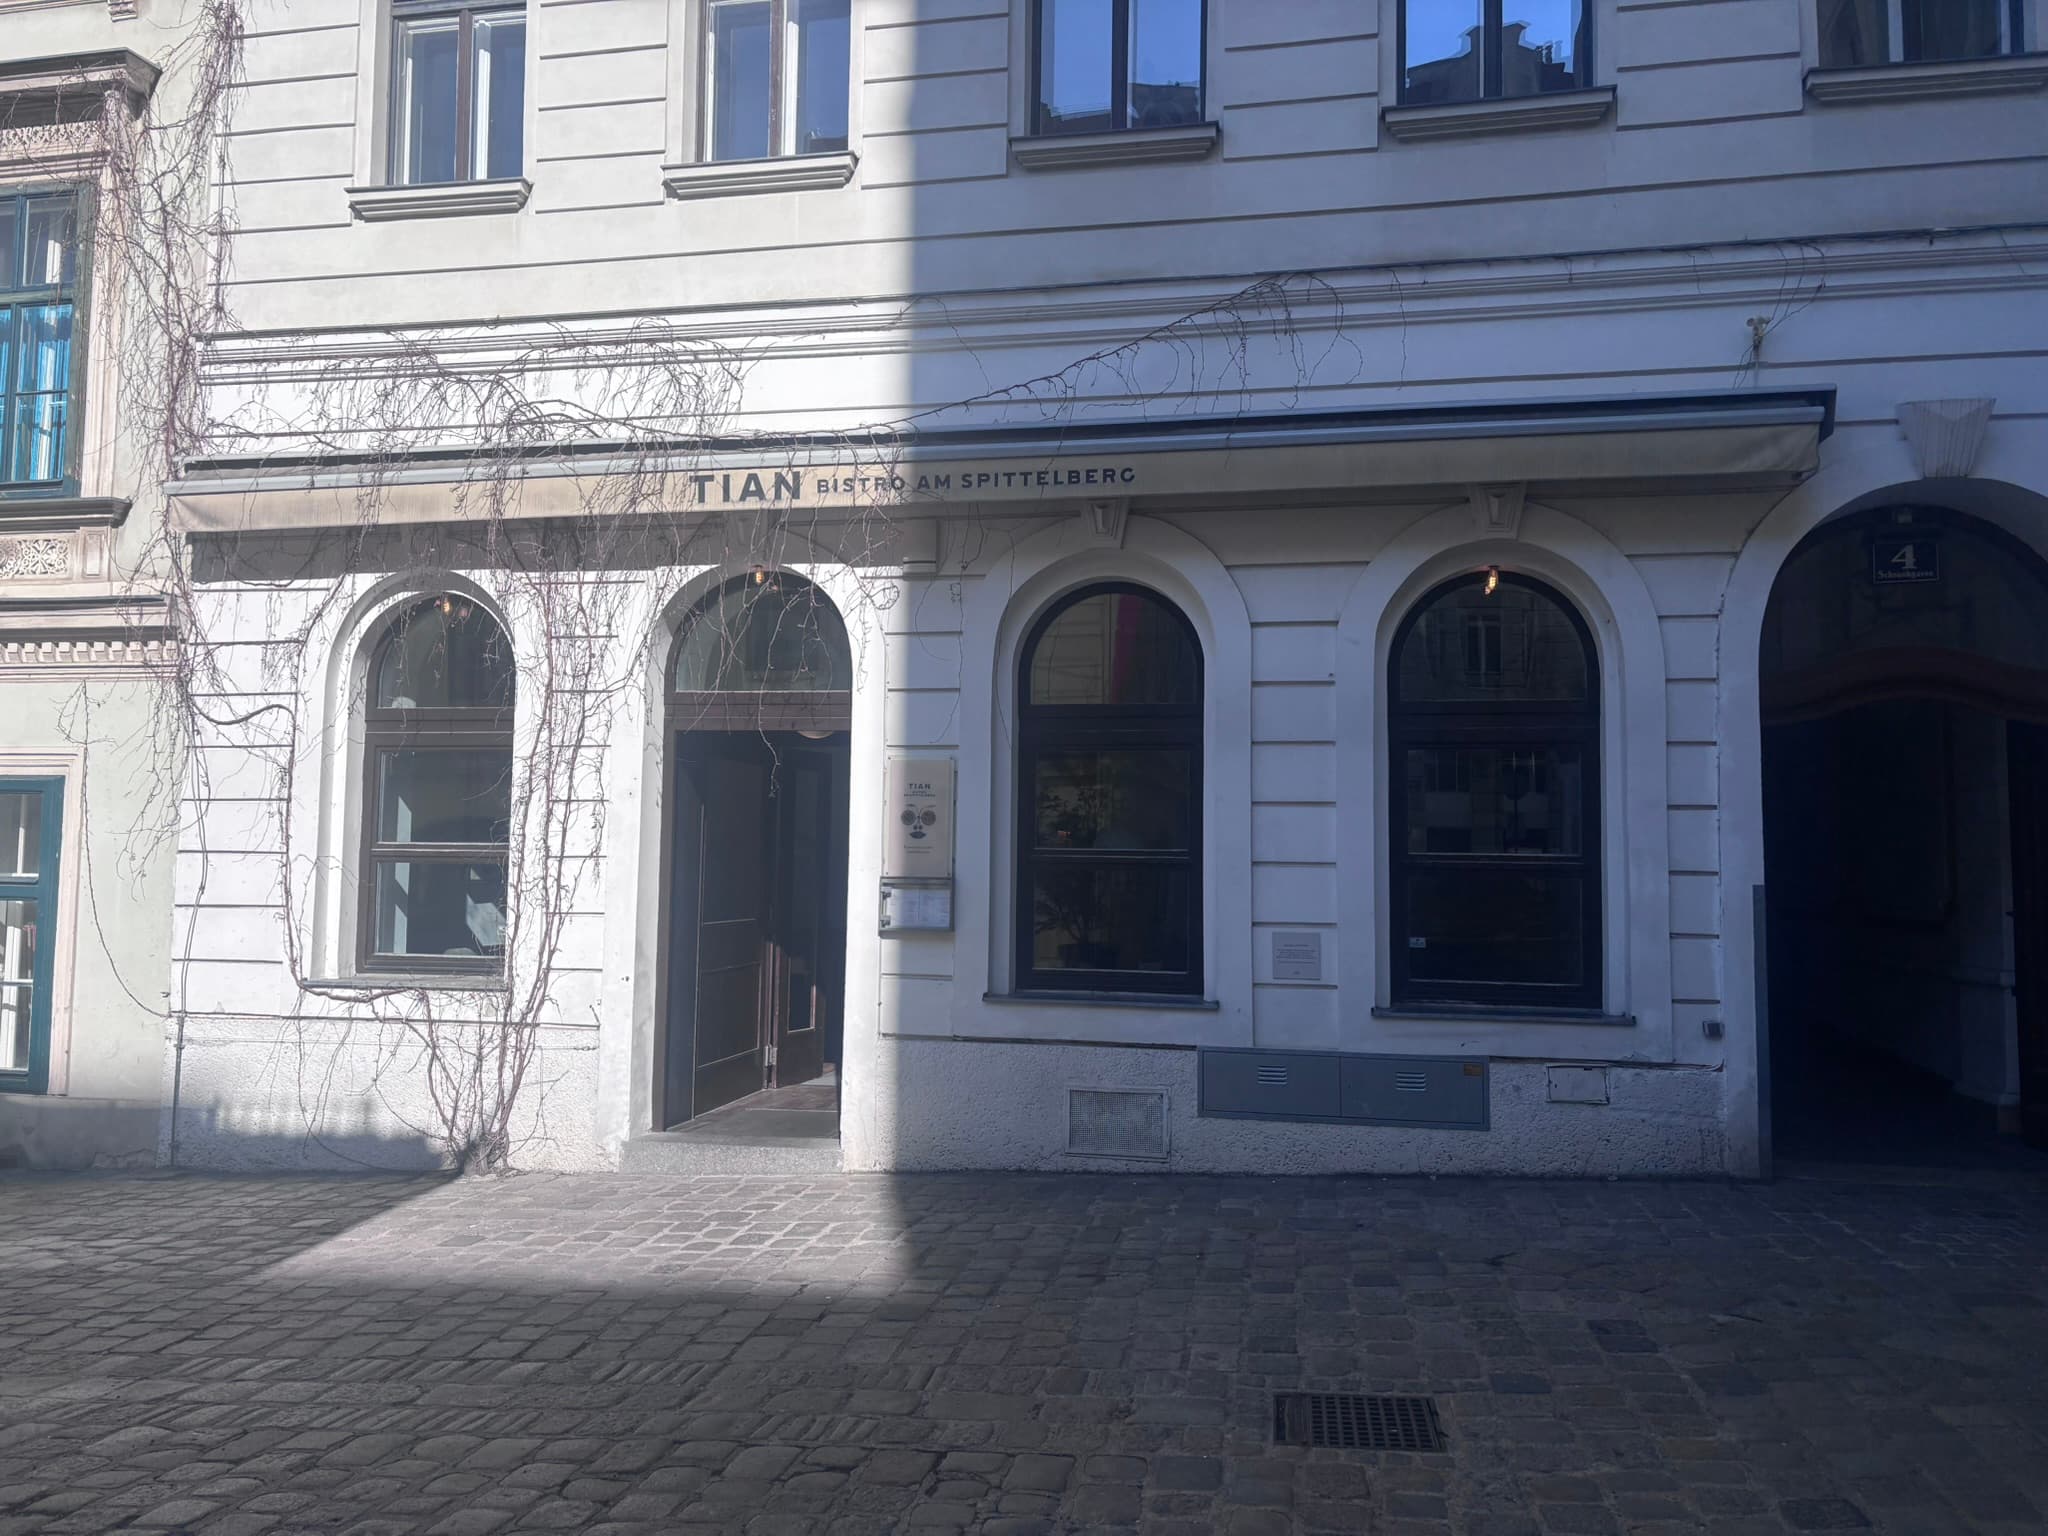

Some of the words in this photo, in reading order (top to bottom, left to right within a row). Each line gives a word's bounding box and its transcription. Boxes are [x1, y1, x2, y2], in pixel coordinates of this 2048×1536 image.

[690, 471, 801, 503] TIAN
[816, 476, 905, 494] BISTRO
[917, 474, 951, 490] AM
[961, 467, 1135, 489] SPITTELBERG
[1891, 544, 1917, 569] 4
